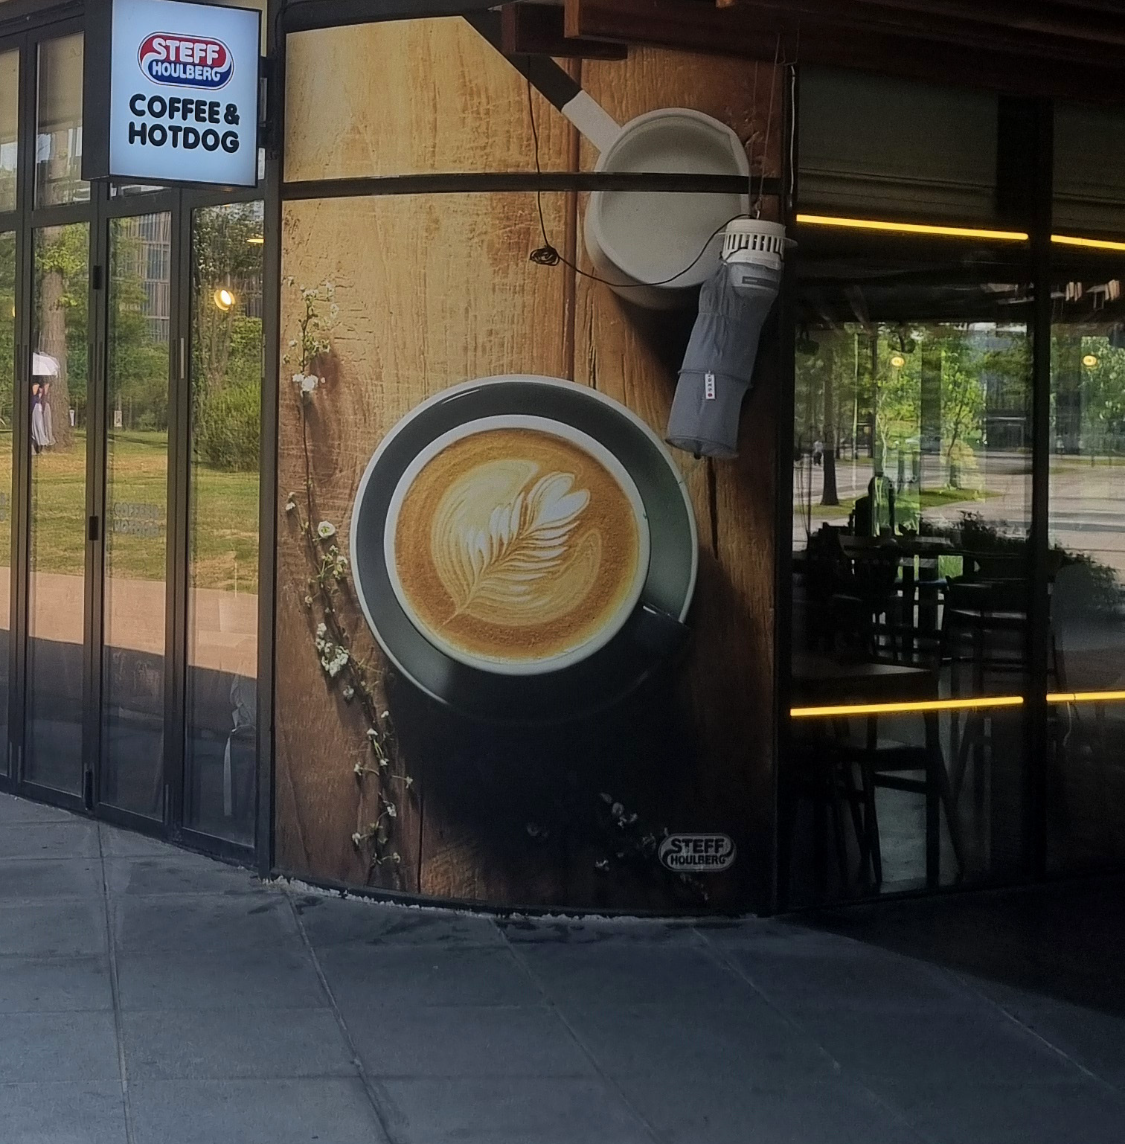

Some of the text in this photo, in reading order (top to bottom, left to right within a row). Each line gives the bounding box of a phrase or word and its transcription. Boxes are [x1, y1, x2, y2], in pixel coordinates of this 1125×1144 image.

[152, 37, 220, 65] STEFF
[152, 61, 221, 82] HOULBERG
[129, 94, 241, 125] COFFEE &
[128, 121, 240, 154] HOTDOG
[671, 838, 725, 854] STEFF
[670, 854, 726, 866] HOULBERG
